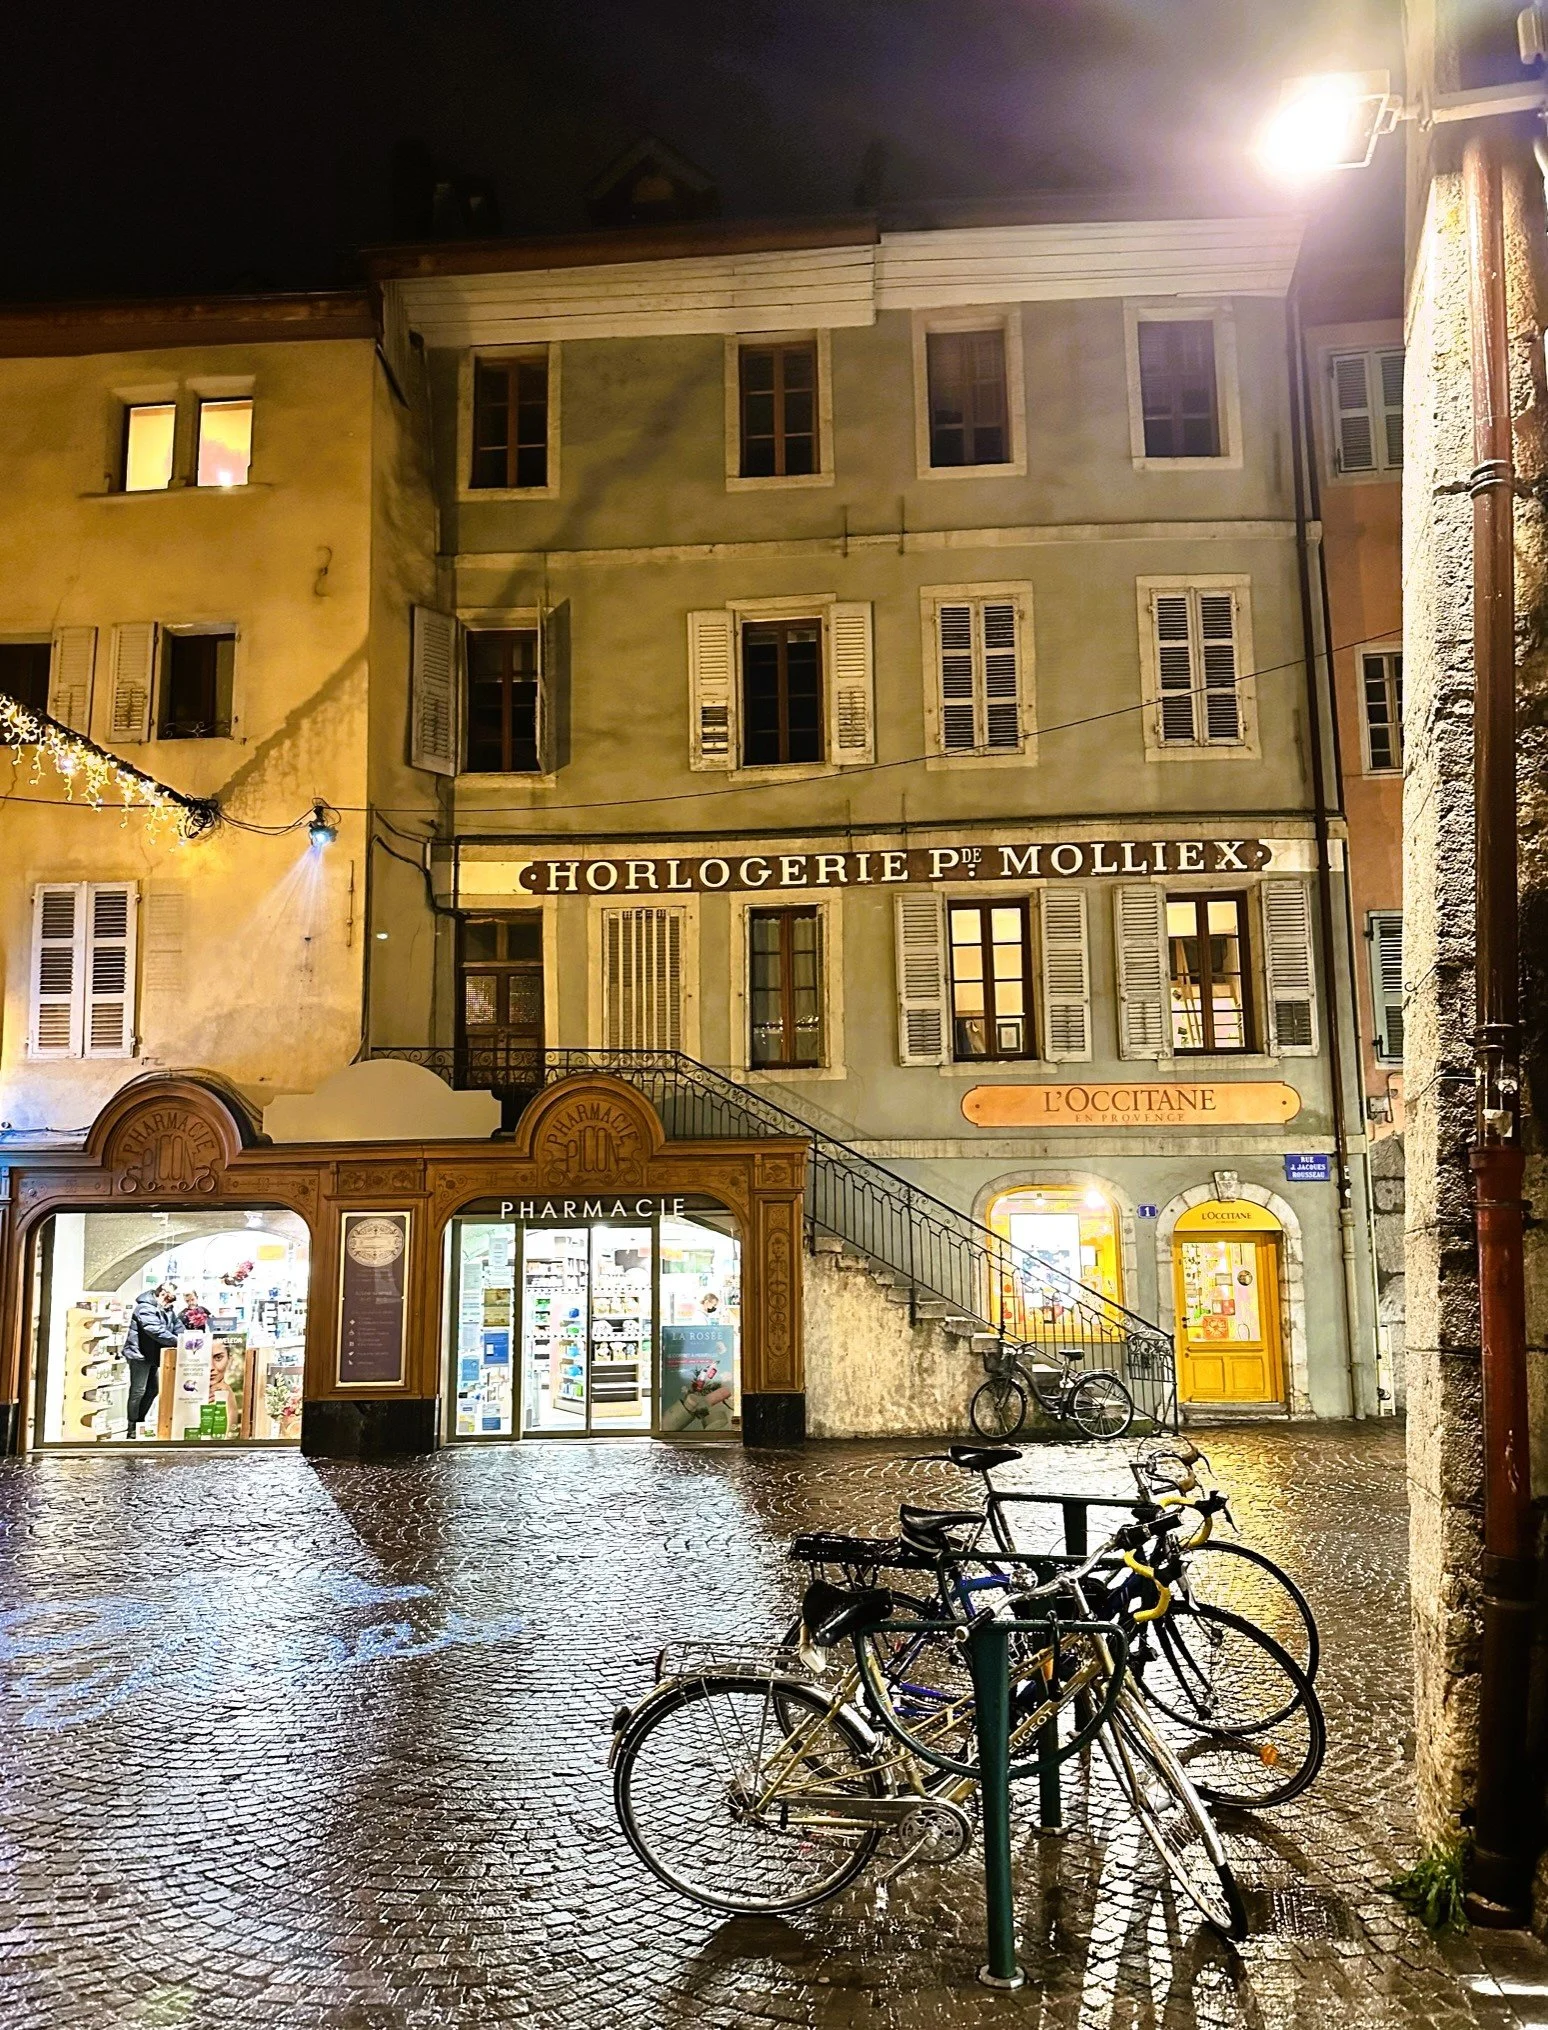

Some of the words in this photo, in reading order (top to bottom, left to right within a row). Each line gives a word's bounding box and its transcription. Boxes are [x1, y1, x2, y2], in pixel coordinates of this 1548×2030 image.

[546, 851, 909, 892] HORLOGERIE
[998, 841, 1248, 877] MOLLIEX
[1043, 1086, 1217, 1113] L'OCCITANE
[546, 1103, 639, 1148] PHARMACIE
[1075, 1113, 1095, 1123] EN
[1101, 1112, 1186, 1123] PROVENCE
[123, 1111, 215, 1155] PHARMACIE
[566, 1125, 620, 1174] PICON
[1292, 1171, 1325, 1179] ROUSSEAU
[1297, 1163, 1327, 1171] JACQUES
[501, 1198, 685, 1220] PHARMACIE
[1144, 1206, 1151, 1217] 1
[672, 1332, 686, 1341] LA
[1008, 1707, 1054, 1755] EUGEOT
